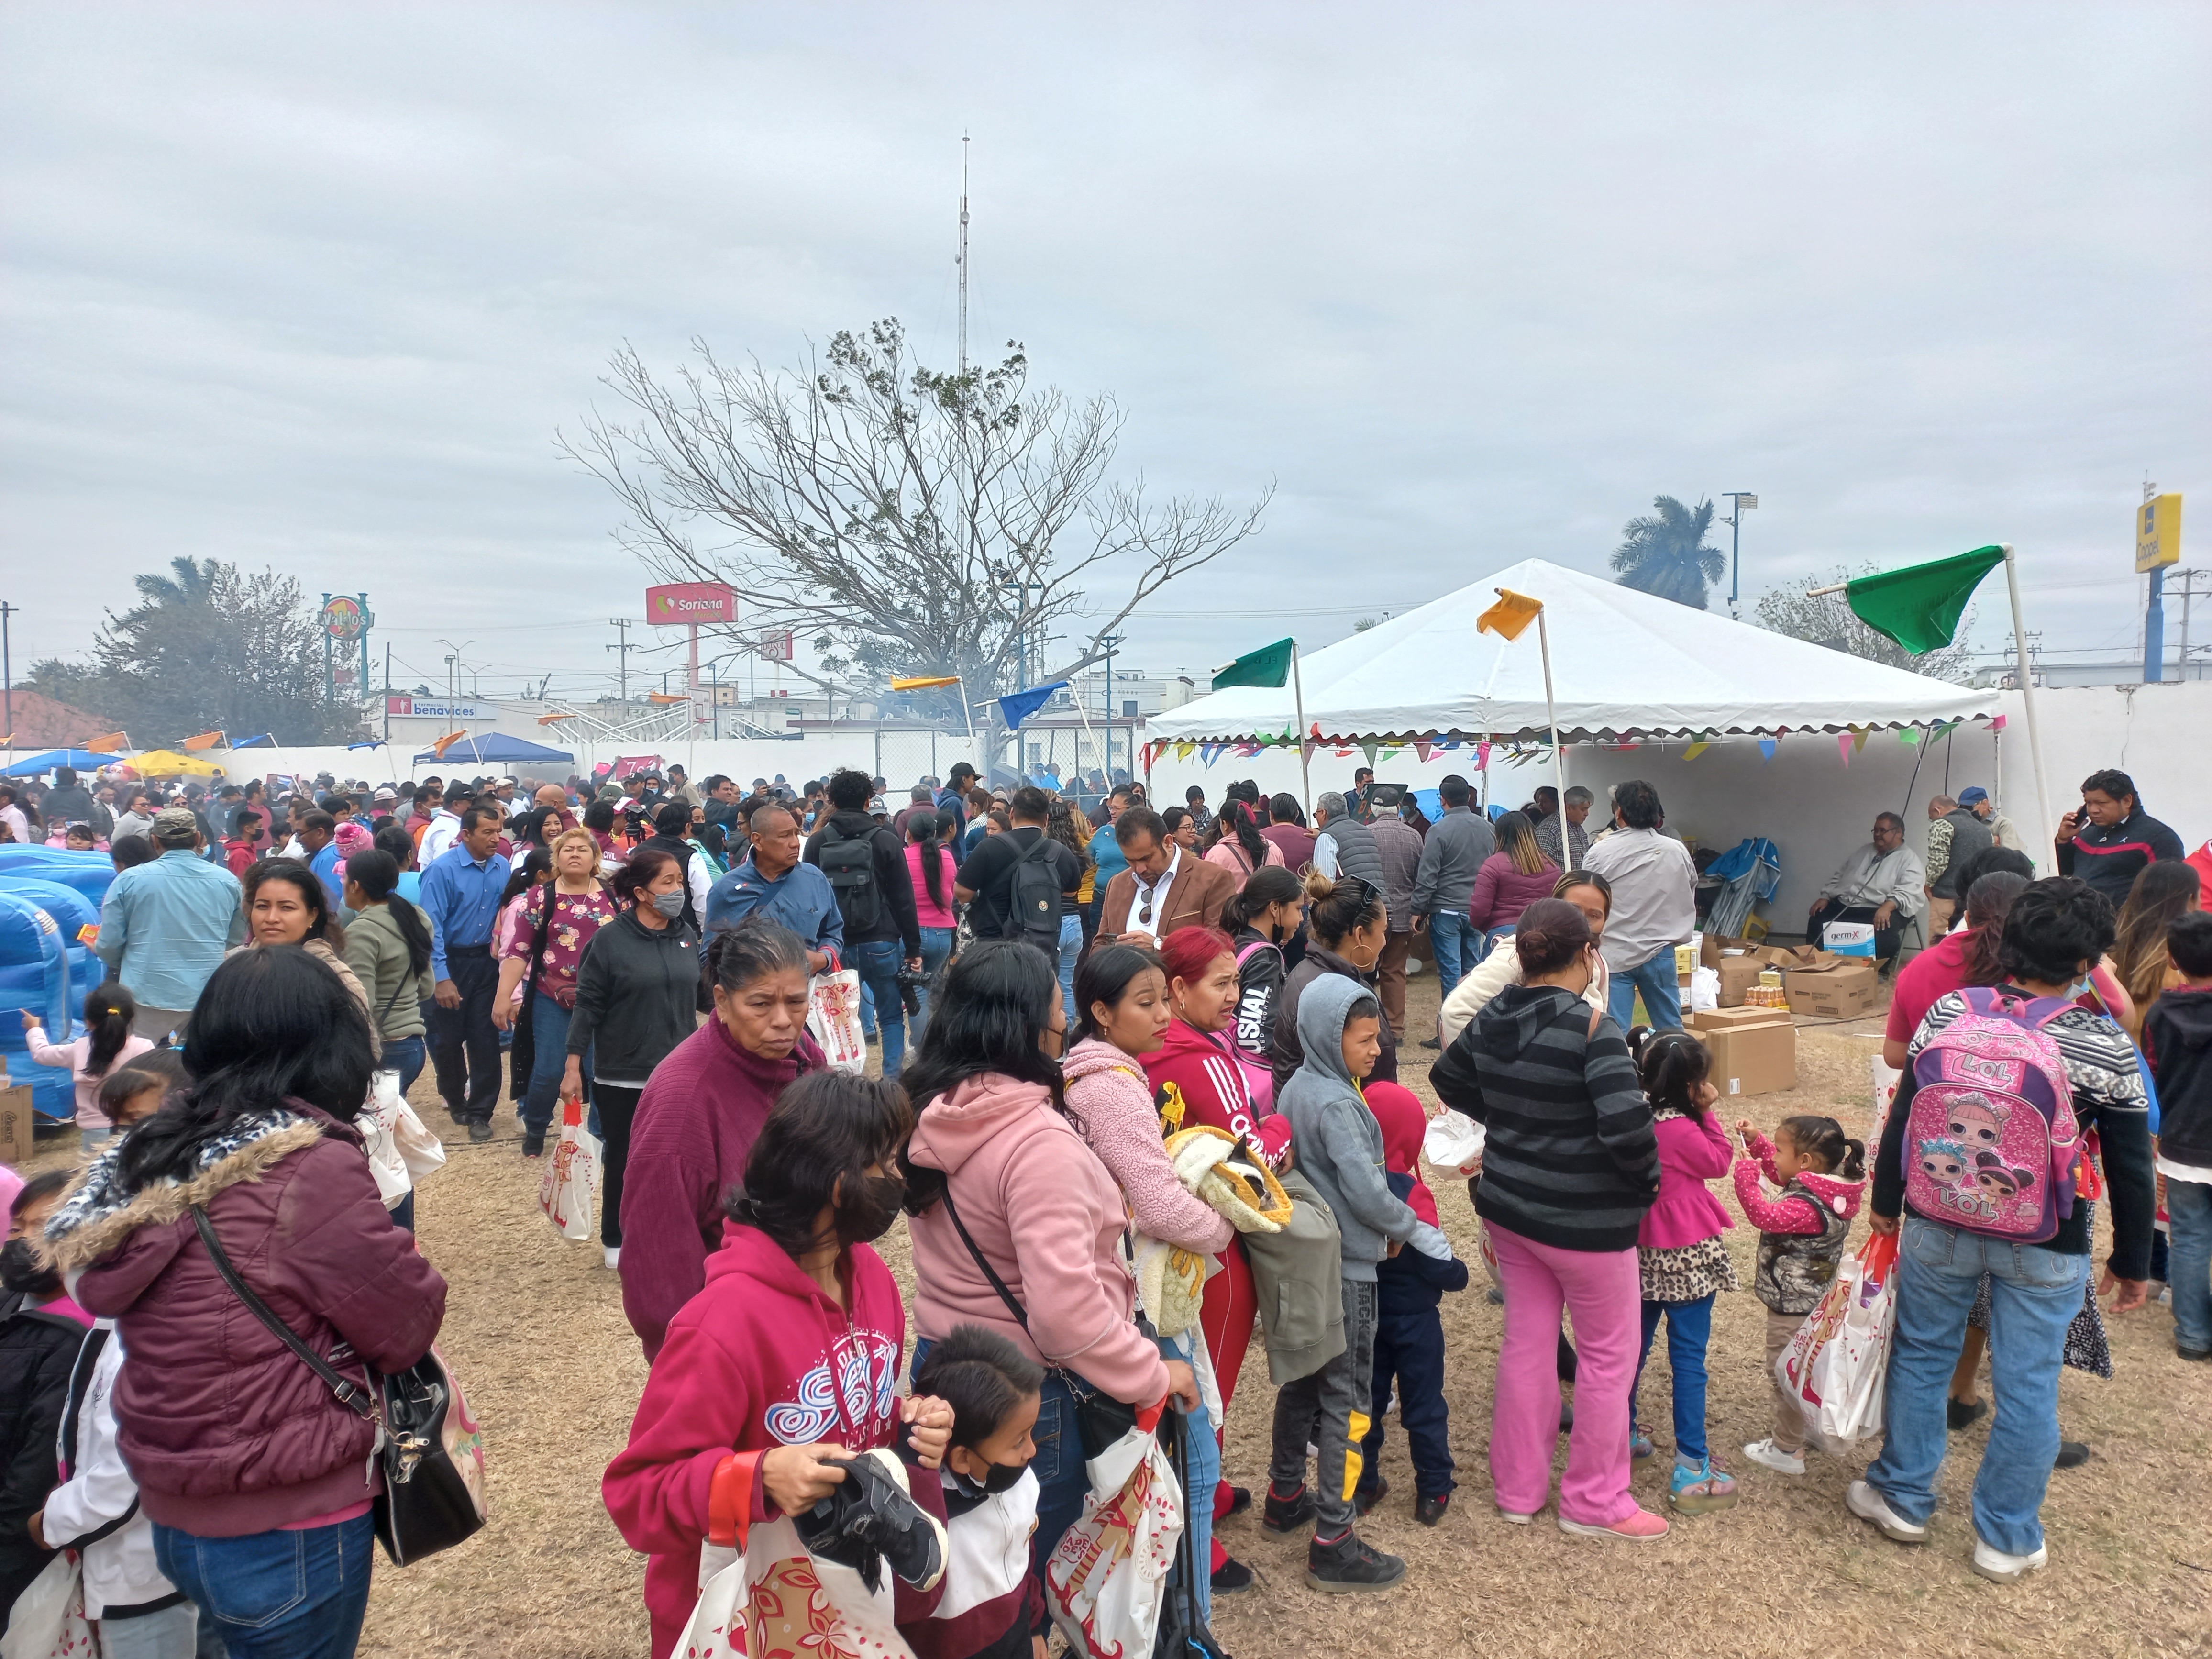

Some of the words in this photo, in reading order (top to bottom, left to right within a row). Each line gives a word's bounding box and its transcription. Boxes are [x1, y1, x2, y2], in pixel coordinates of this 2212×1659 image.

[2136, 534, 2159, 563] Coppel
[678, 597, 723, 611] Soriana
[603, 851, 617, 860] CIVIL
[1237, 985, 1270, 1054] USUAL
